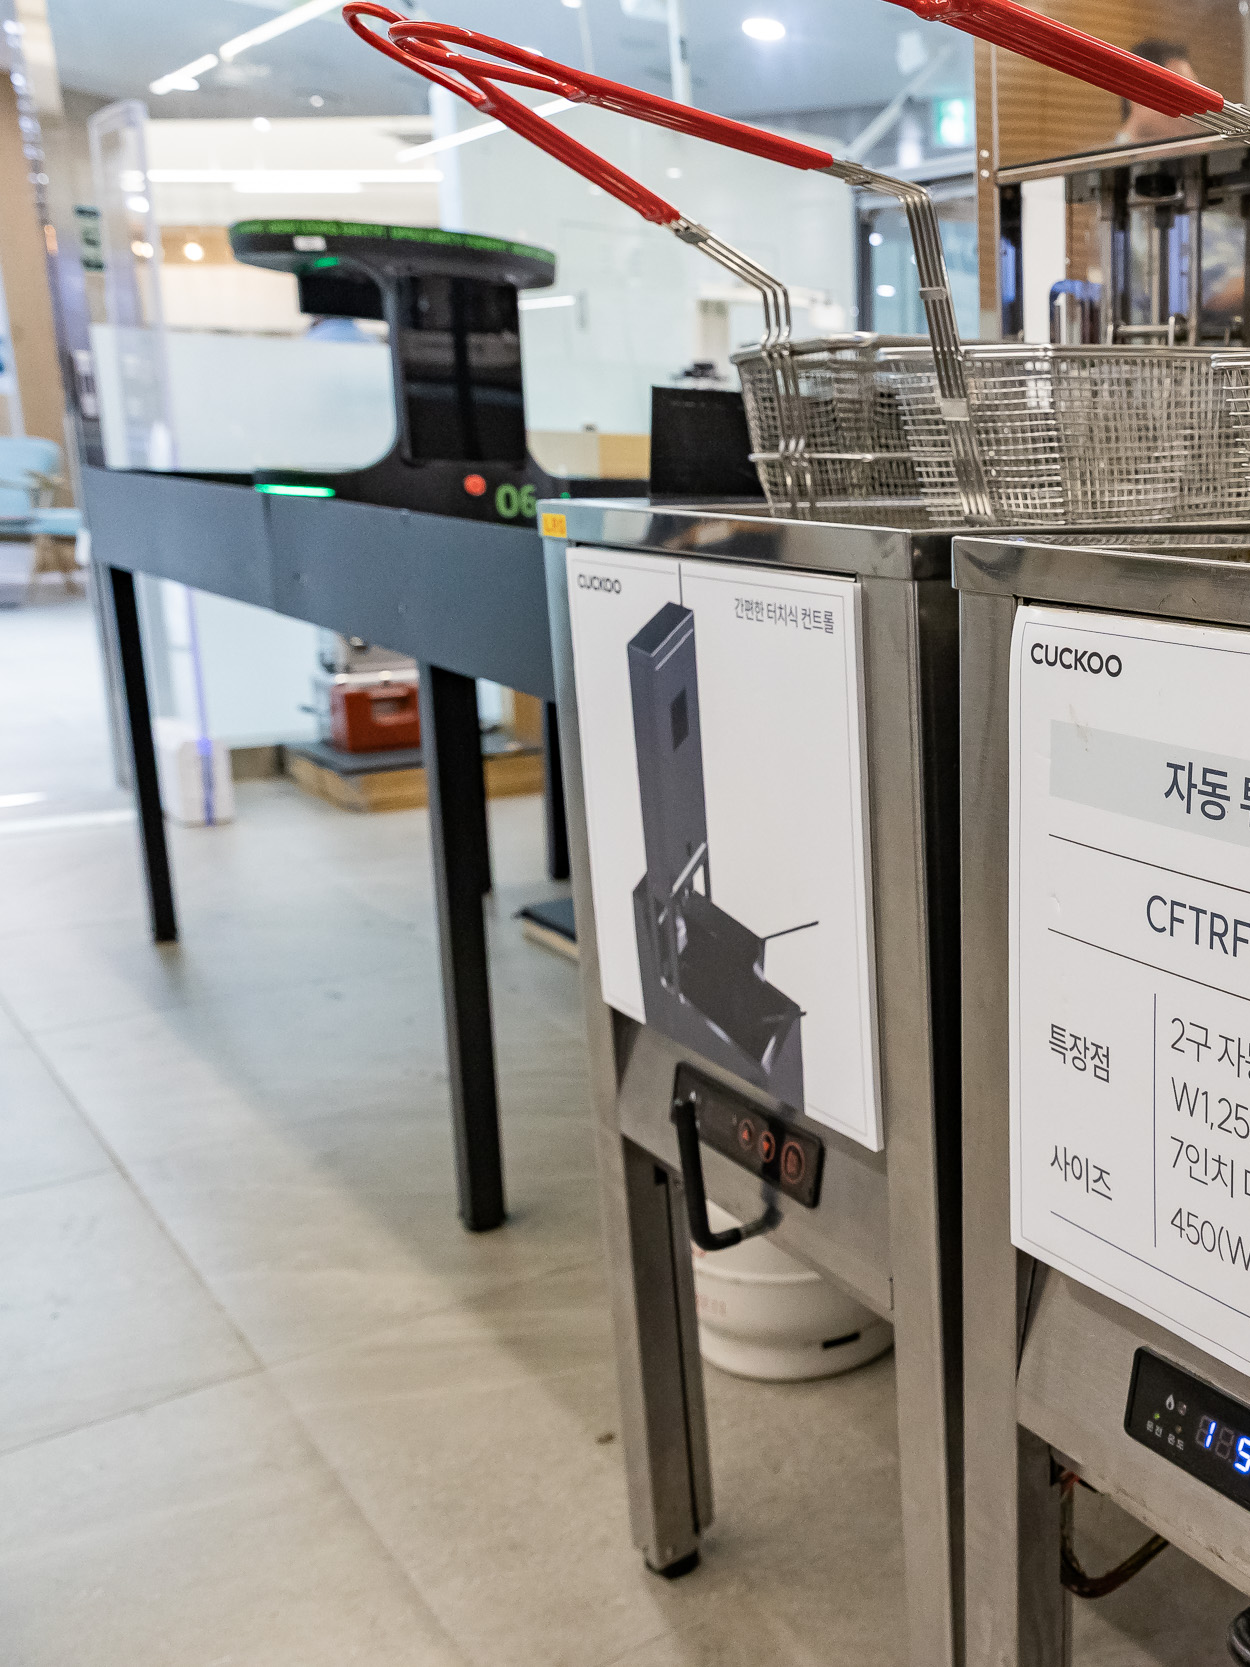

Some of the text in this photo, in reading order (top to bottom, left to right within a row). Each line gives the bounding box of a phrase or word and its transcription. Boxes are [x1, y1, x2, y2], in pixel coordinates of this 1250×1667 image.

[577, 573, 622, 594] CUCKOO
[735, 597, 835, 635] 간편한 터치식 컨트롤
[1030, 642, 1122, 678] CUCKOO
[1164, 761, 1231, 821] 자동
[1048, 1023, 1111, 1083] 특장점
[1170, 1017, 1212, 1062] 2구
[1050, 1145, 1113, 1201] 사이즈
[1170, 1136, 1234, 1199] 7인치
